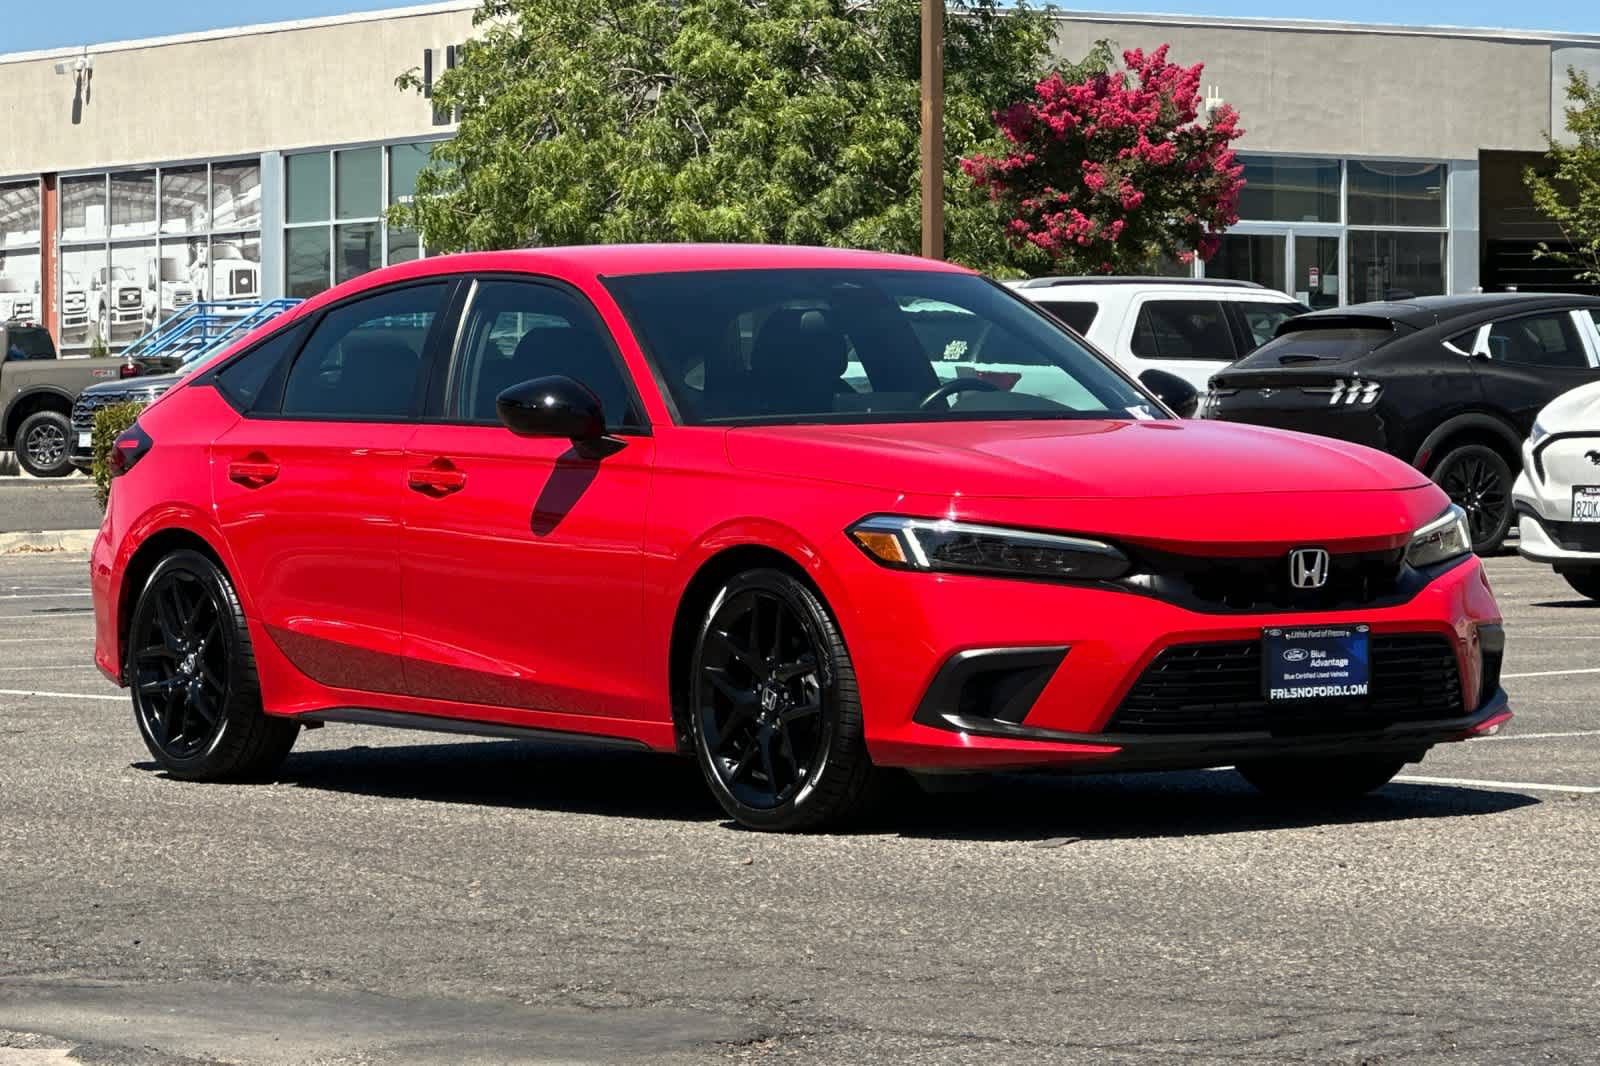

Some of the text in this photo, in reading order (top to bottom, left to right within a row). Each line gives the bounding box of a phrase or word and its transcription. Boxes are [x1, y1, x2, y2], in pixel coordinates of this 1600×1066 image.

[1310, 649, 1326, 658] Blue
[1310, 658, 1349, 668] Advantage
[1330, 670, 1349, 678] Vehicle
